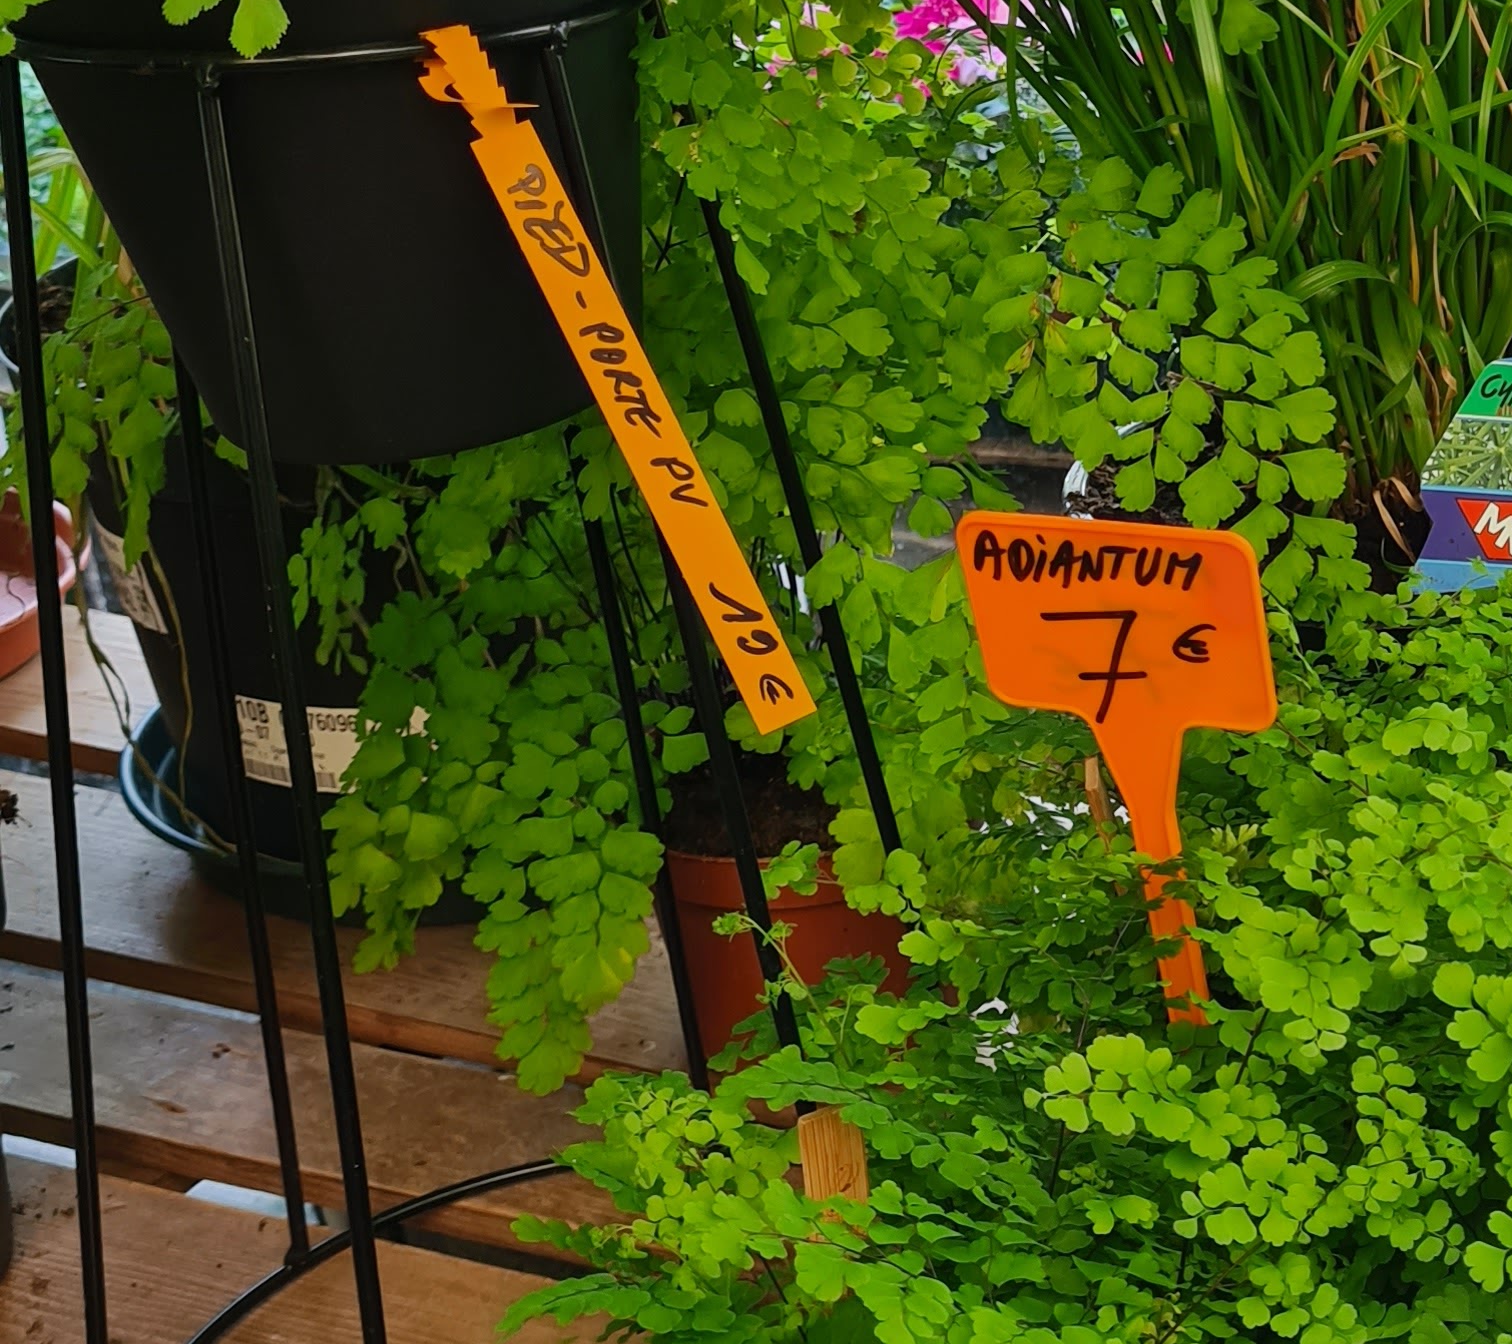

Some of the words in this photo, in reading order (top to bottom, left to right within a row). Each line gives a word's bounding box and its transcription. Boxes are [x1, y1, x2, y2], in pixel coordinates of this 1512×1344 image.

[507, 163, 591, 277] PIED
[578, 322, 662, 439] PORTE
[650, 457, 708, 509] PV
[1040, 610, 1148, 724] 7
